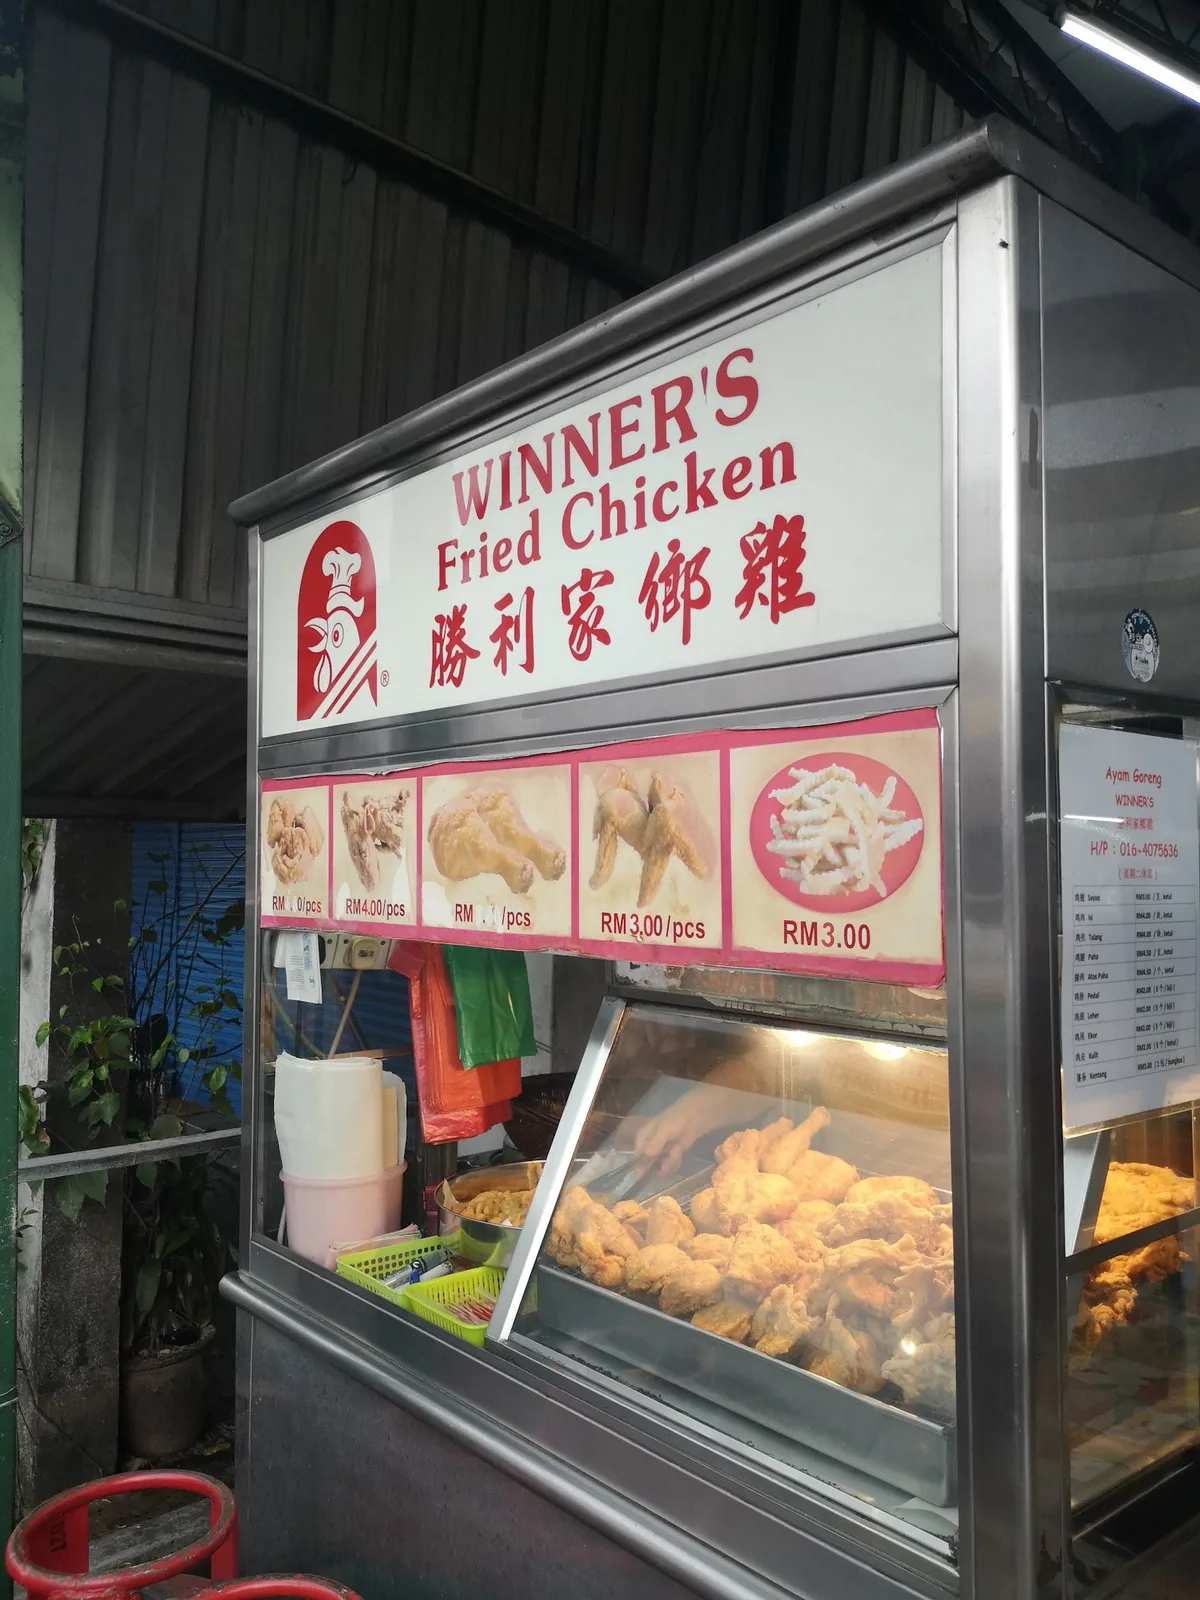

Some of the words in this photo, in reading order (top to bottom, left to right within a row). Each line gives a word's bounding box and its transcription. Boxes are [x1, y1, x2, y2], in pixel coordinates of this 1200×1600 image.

[451, 348, 759, 526] WINNER'S
[437, 508, 542, 591] Fried
[561, 441, 797, 550] Chicken
[1105, 767, 1129, 785] Ayam
[1133, 769, 1162, 788] Goreng
[1115, 794, 1154, 808] WINNER'S
[1091, 841, 1108, 856] H/P
[1120, 842, 1178, 857] 016-4075636
[272, 895, 322, 915] RM.0/pcs
[346, 898, 405, 921] RM4.00/pcs
[455, 903, 531, 929] RM./pcs
[601, 912, 706, 942] RM3.00/pcs
[783, 920, 871, 950] RM3.00
[1088, 953, 1099, 961] Paha
[1087, 991, 1100, 999] Pedal
[1087, 1012, 1099, 1020] Leher
[1089, 1071, 1107, 1079] Kentang
